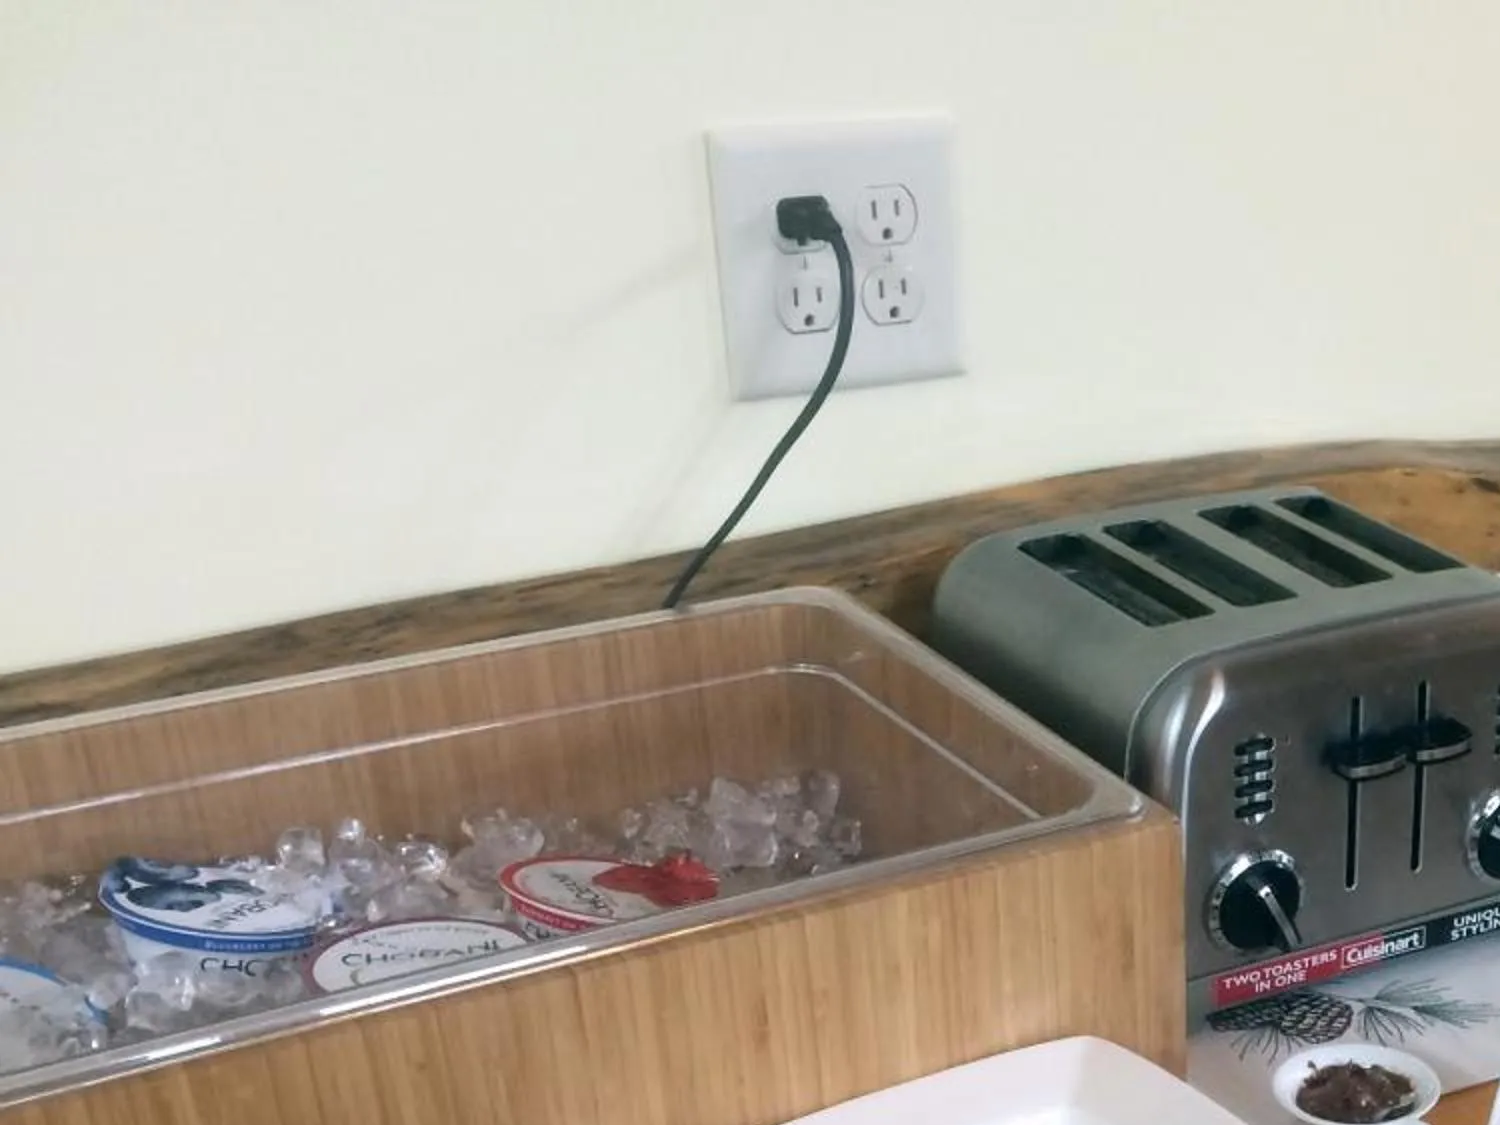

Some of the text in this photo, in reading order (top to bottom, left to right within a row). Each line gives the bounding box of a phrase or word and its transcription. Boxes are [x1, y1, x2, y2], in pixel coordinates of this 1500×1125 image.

[1346, 932, 1420, 964] Cuisinart
[1222, 949, 1338, 990] TWO TOASTERS
[1255, 969, 1308, 993] IN ONE
